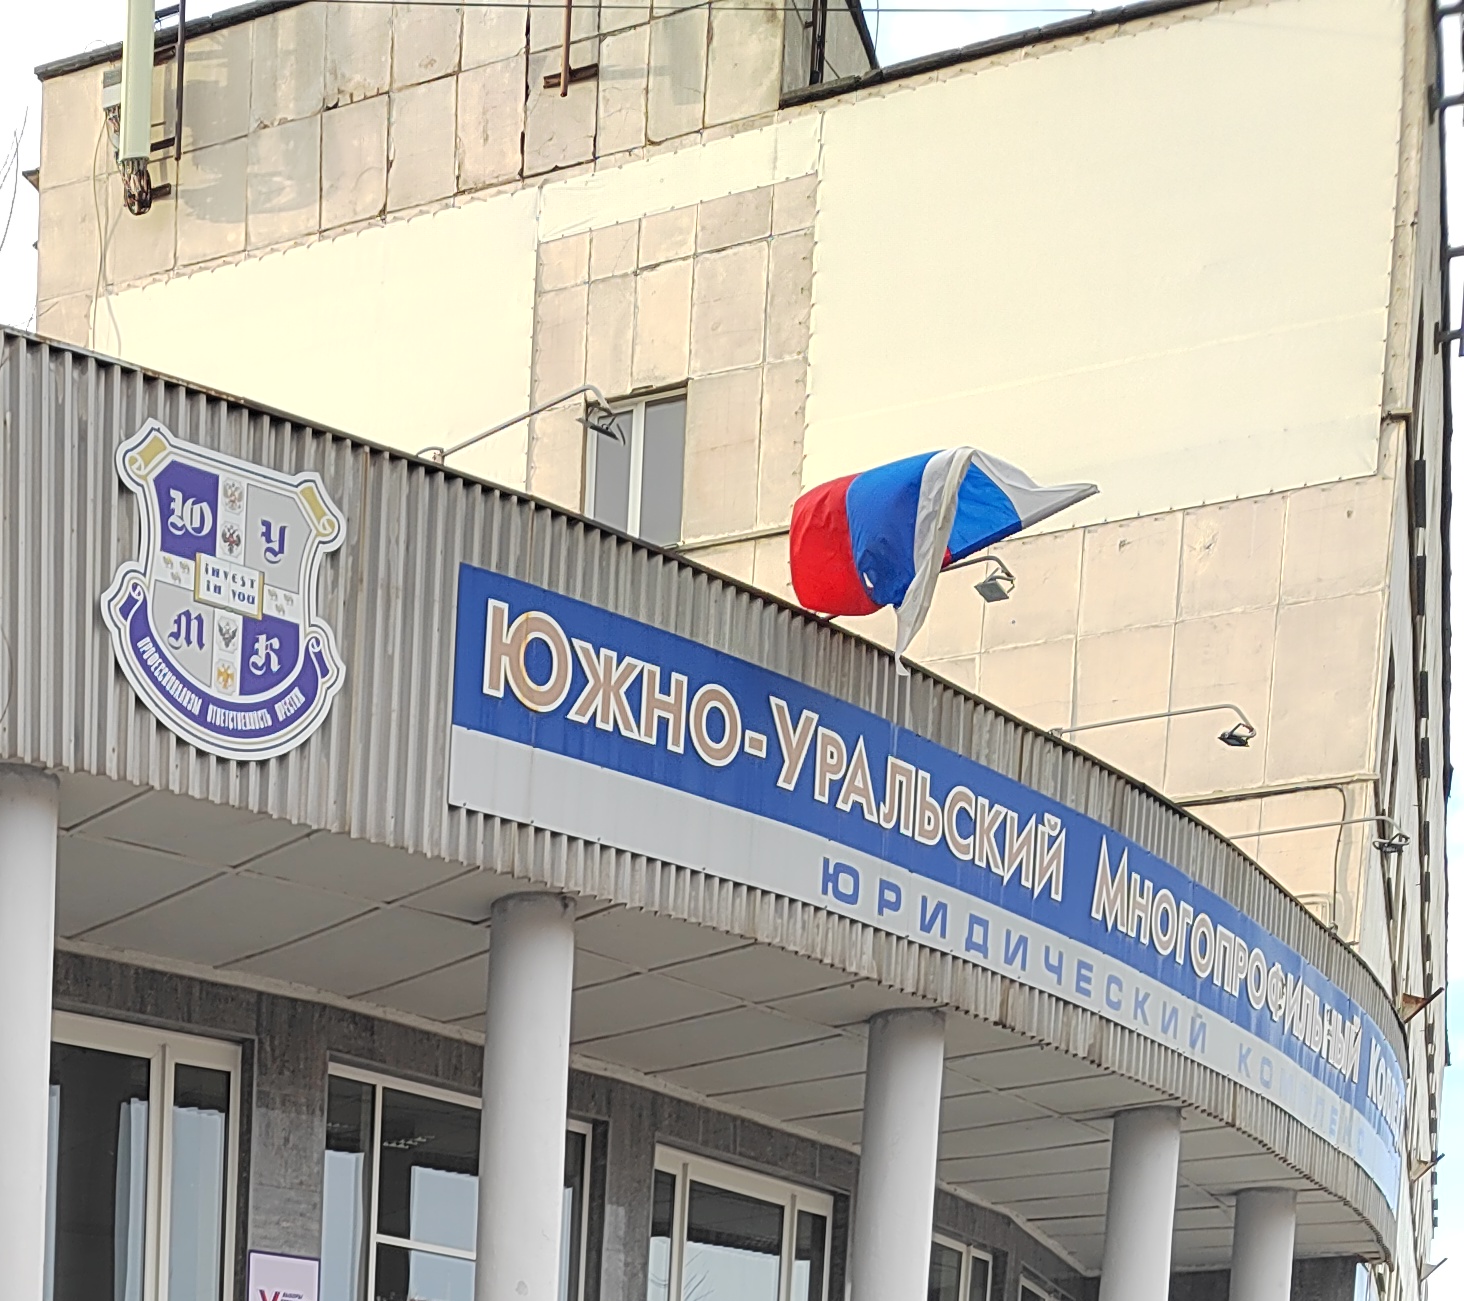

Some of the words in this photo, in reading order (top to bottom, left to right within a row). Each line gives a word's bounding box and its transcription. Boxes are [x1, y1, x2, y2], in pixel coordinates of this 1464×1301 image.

[136, 636, 203, 716] ПРОФЕССИОНАЛИЗМ
[482, 598, 1066, 902] ЮЖНО-УРАЛЬСКИЙ
[1090, 832, 1363, 1085] МНОГОПРОФИЛЬНЫЙ
[821, 856, 1207, 1056] ЮРИДИЧЕСКИЙ
